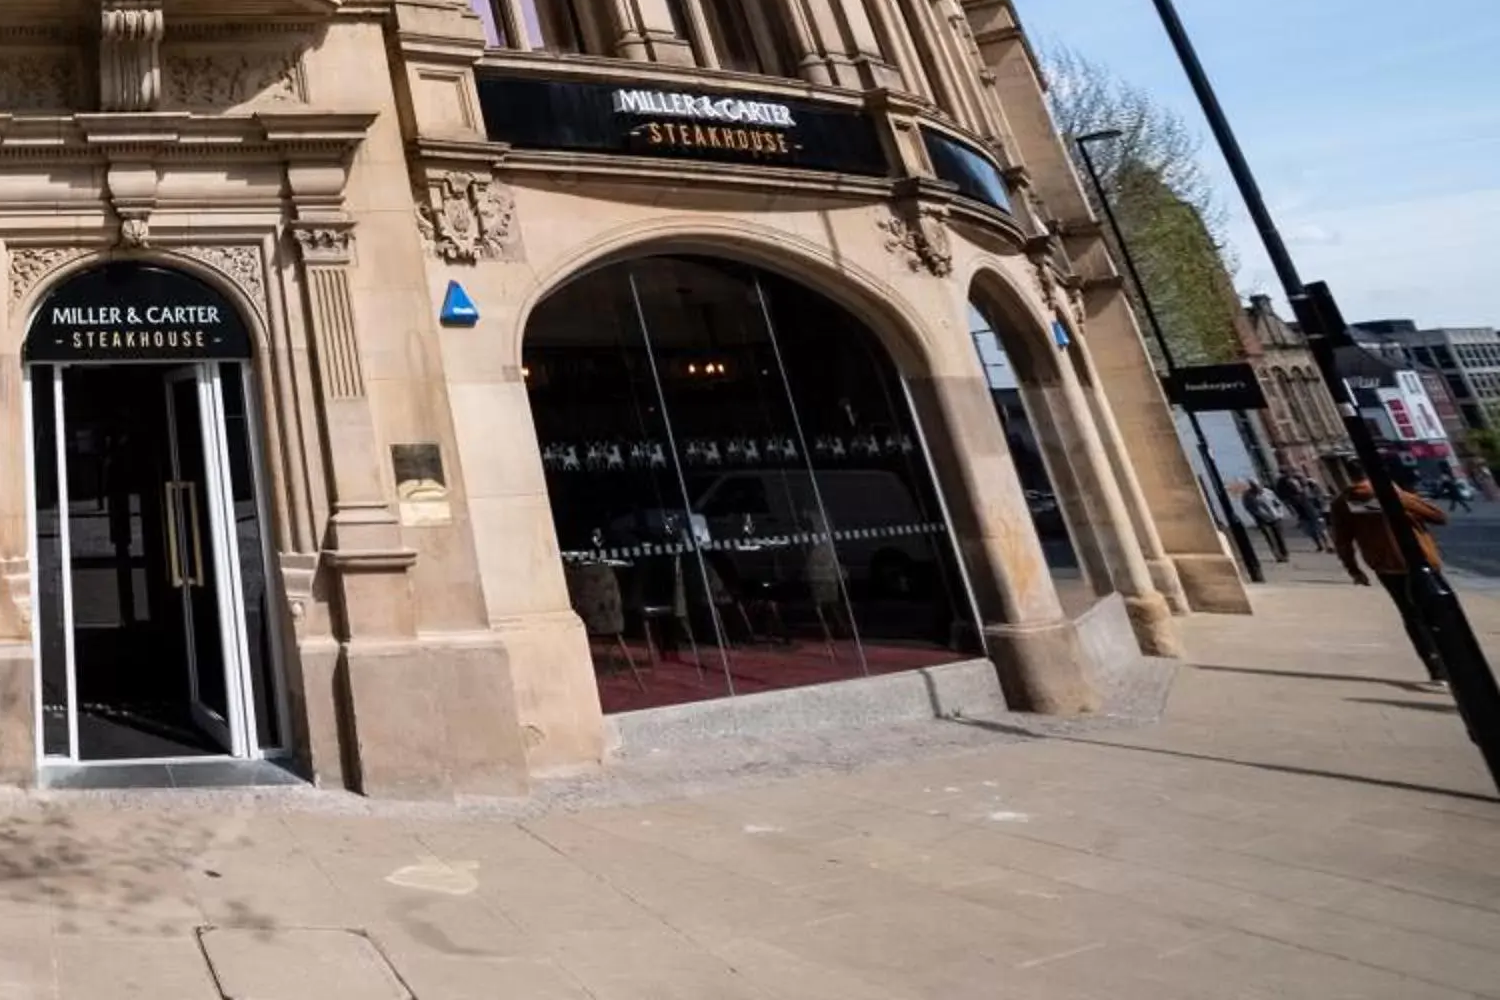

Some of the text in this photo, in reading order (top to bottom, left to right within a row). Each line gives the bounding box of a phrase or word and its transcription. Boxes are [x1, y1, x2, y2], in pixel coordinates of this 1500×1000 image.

[613, 88, 699, 116] MILLER
[719, 98, 797, 127] CARTER
[651, 122, 789, 154] STEAKHOUSE
[52, 305, 221, 326] MILLER & CARTER
[72, 330, 205, 349] STEAKHOUSE
